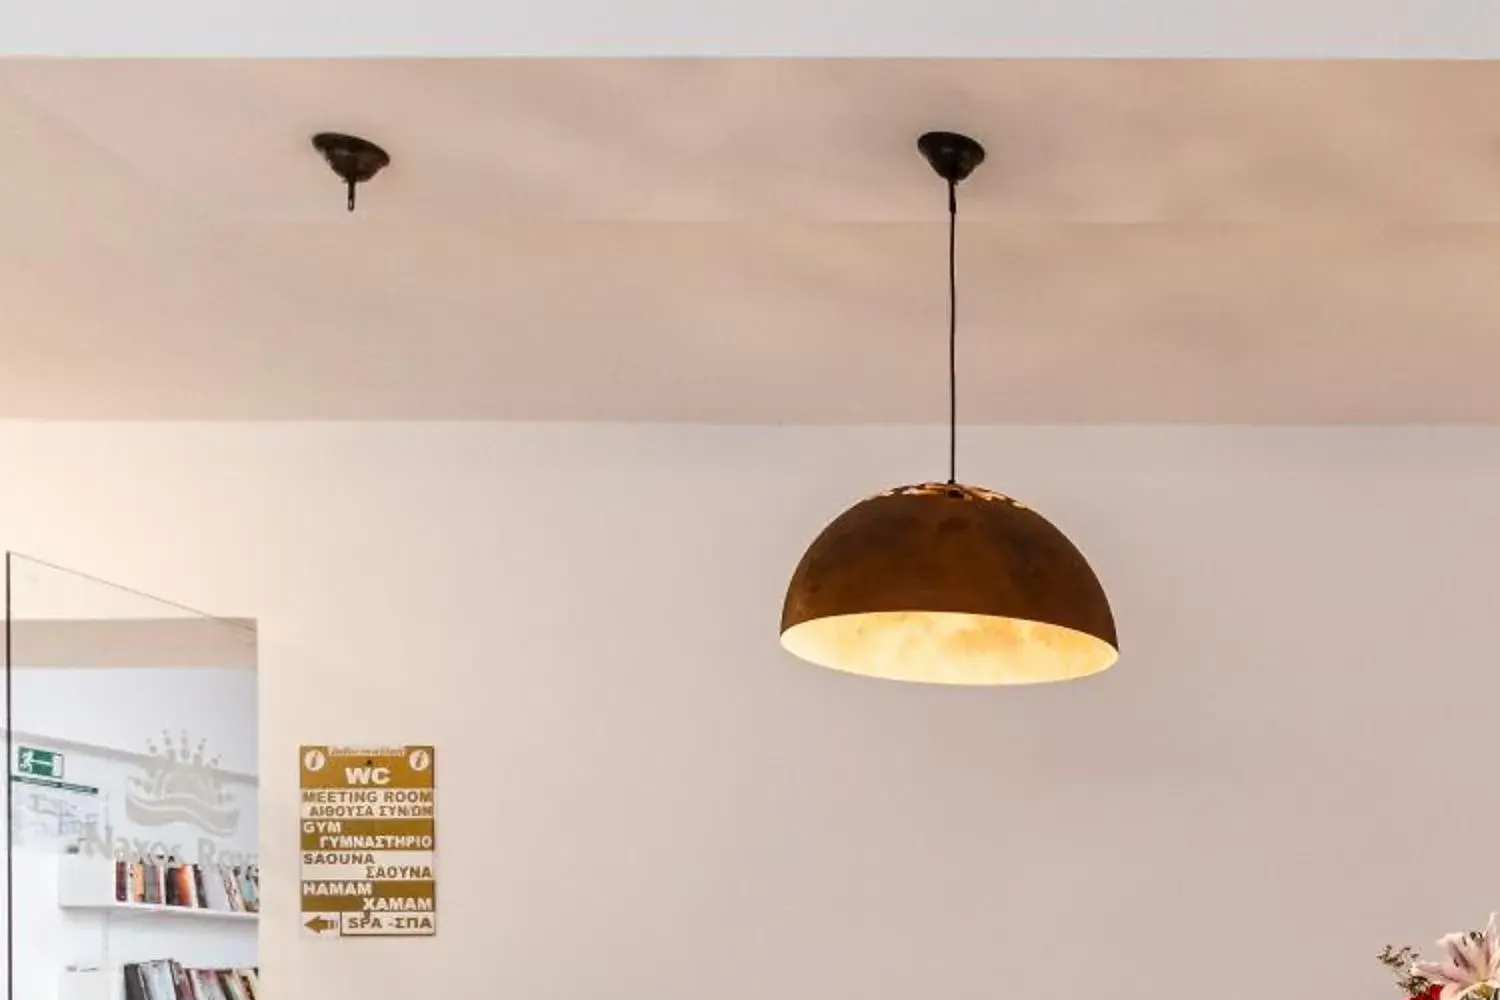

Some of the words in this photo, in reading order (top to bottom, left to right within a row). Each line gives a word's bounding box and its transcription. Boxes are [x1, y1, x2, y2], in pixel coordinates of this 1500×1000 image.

[345, 767, 391, 784] WC
[302, 791, 377, 803] MEETING
[384, 791, 432, 803] ROOM
[309, 805, 373, 817] ΑΙΘΟΥΣΑ
[303, 821, 341, 833] GYM
[319, 836, 433, 849] ΓΥΜΝΑΣΤΗΡΙΟ
[303, 853, 375, 865] SAOUNA
[365, 866, 432, 879] ΣΑΟΥΝΑ
[303, 882, 373, 896] HAMAM
[362, 897, 433, 911] ΧΑΜΑΜ
[348, 917, 382, 929] SPA
